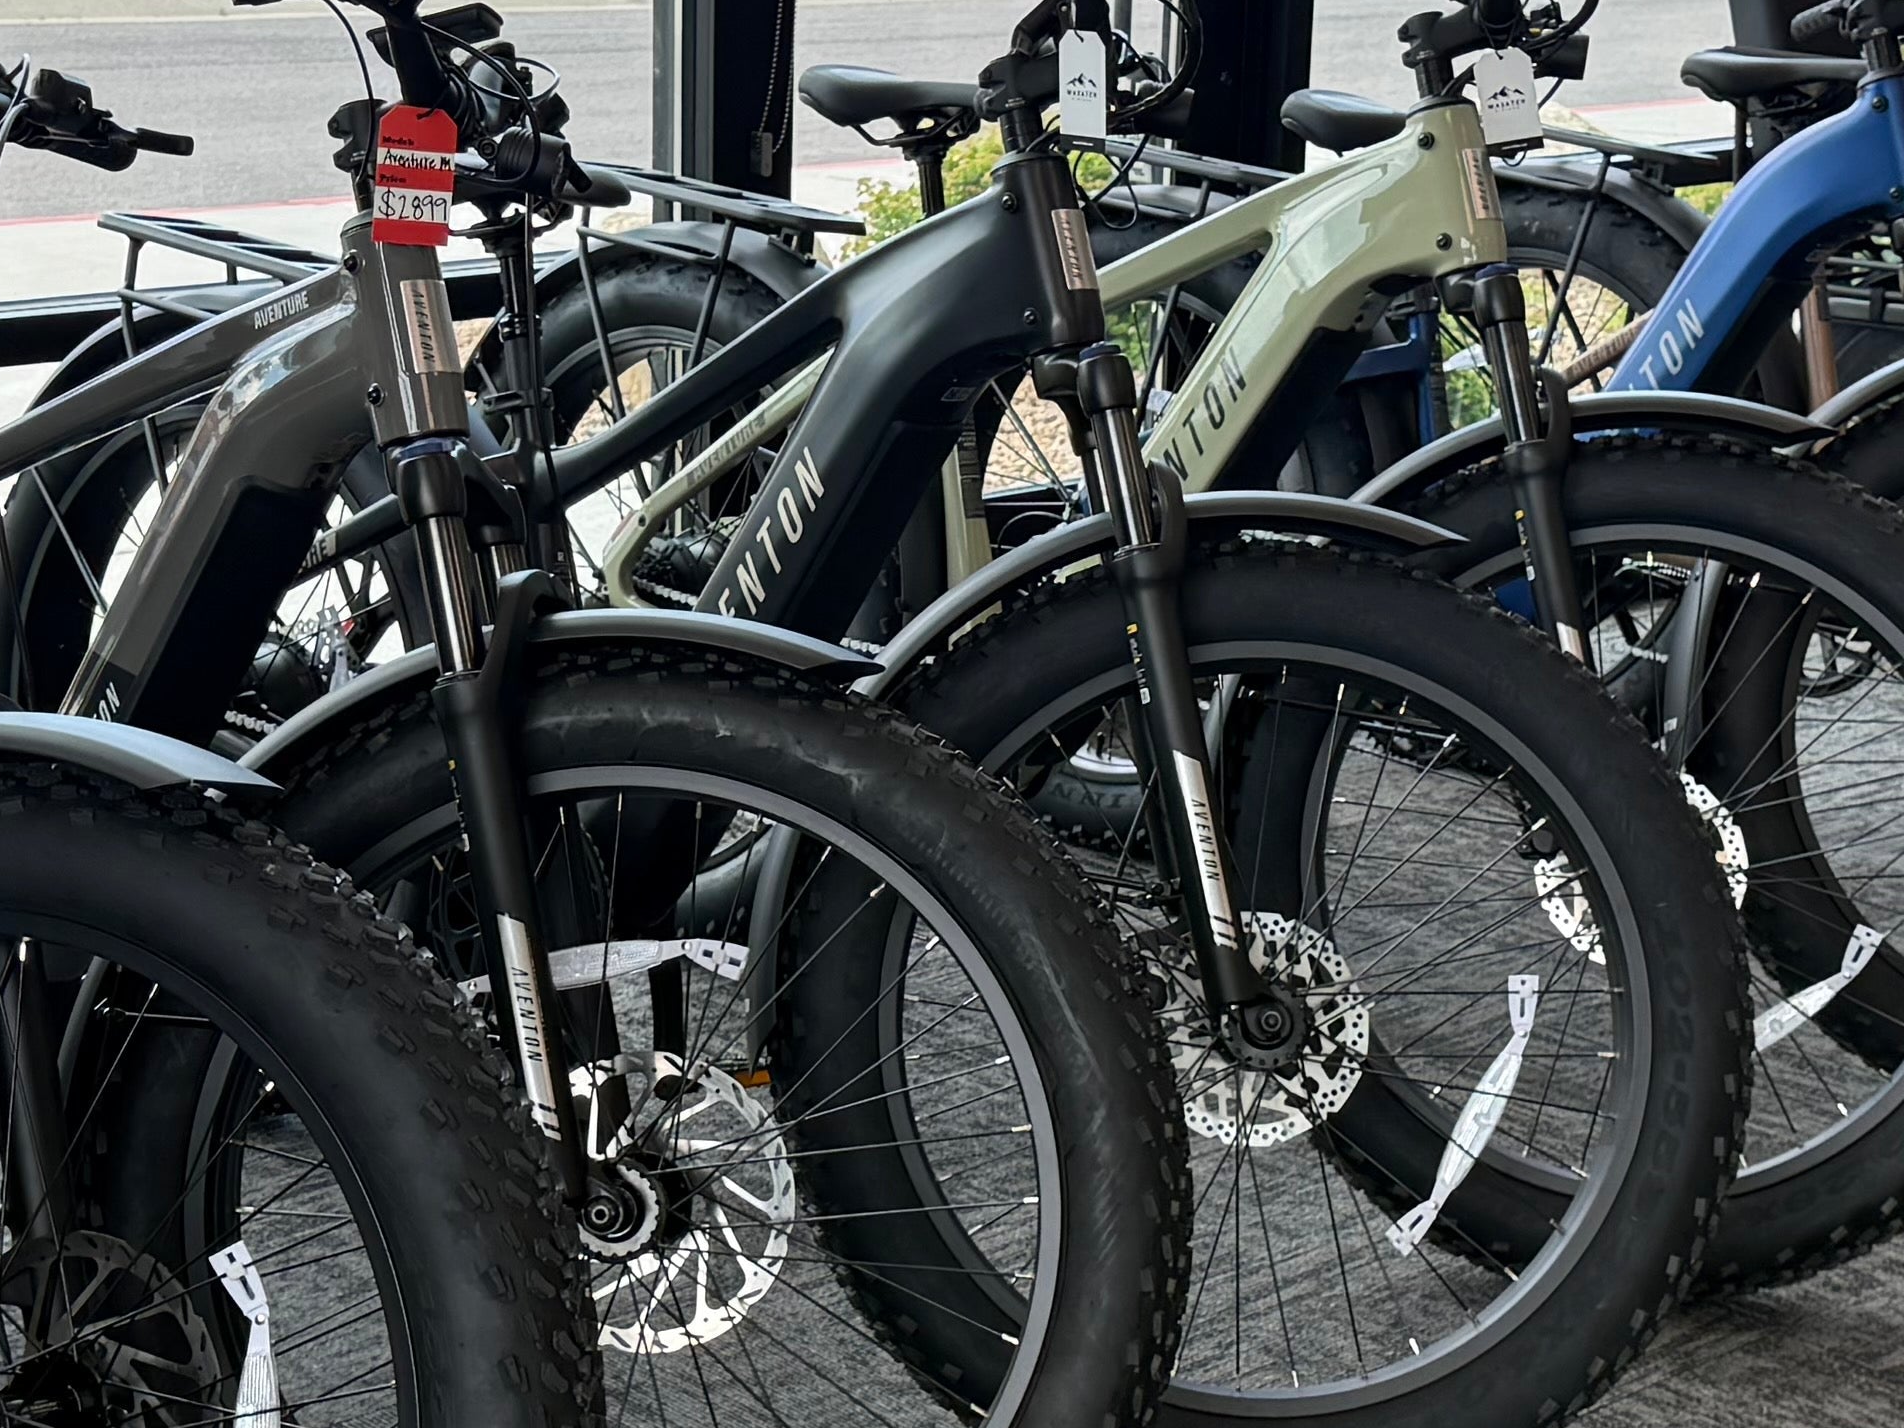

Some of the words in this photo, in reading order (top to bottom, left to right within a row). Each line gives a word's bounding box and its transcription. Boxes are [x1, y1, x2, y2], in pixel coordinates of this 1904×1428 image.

[377, 189, 448, 223] $2899
[253, 291, 310, 330] AVENTURE
[413, 287, 436, 364] AVENTON
[718, 446, 826, 620] ENTON
[1189, 795, 1221, 882] AVENTON
[509, 965, 542, 1063] AVENTON
